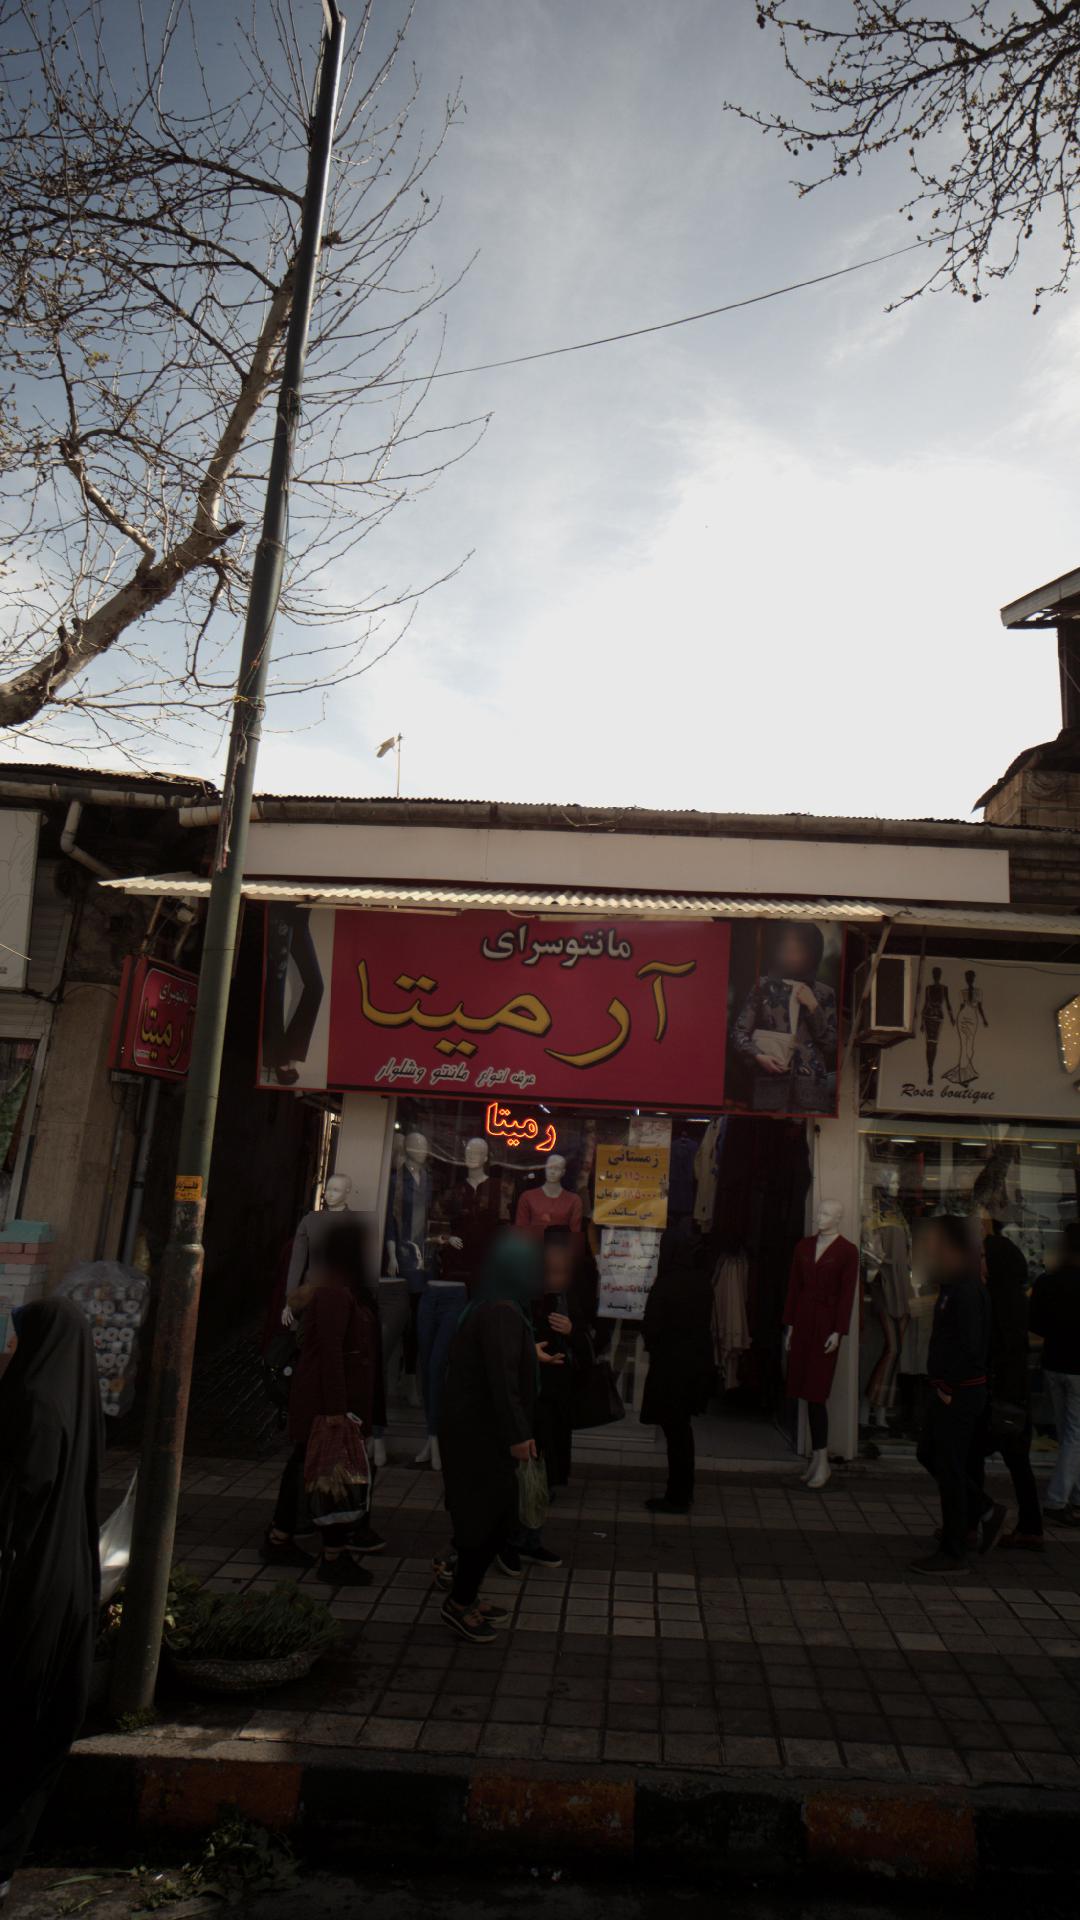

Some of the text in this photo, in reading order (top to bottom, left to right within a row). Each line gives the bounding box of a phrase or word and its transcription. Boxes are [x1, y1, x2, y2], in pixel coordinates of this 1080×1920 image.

[482, 924, 632, 968] مانتوسرای
[356, 959, 697, 1069] آرمیتا
[429, 1062, 470, 1085] مانتو
[475, 1066, 510, 1088] انواع
[510, 1070, 536, 1089] عرضه
[900, 1083, 995, 1104] Rosa boutique
[608, 1150, 659, 1168] زمستانی
